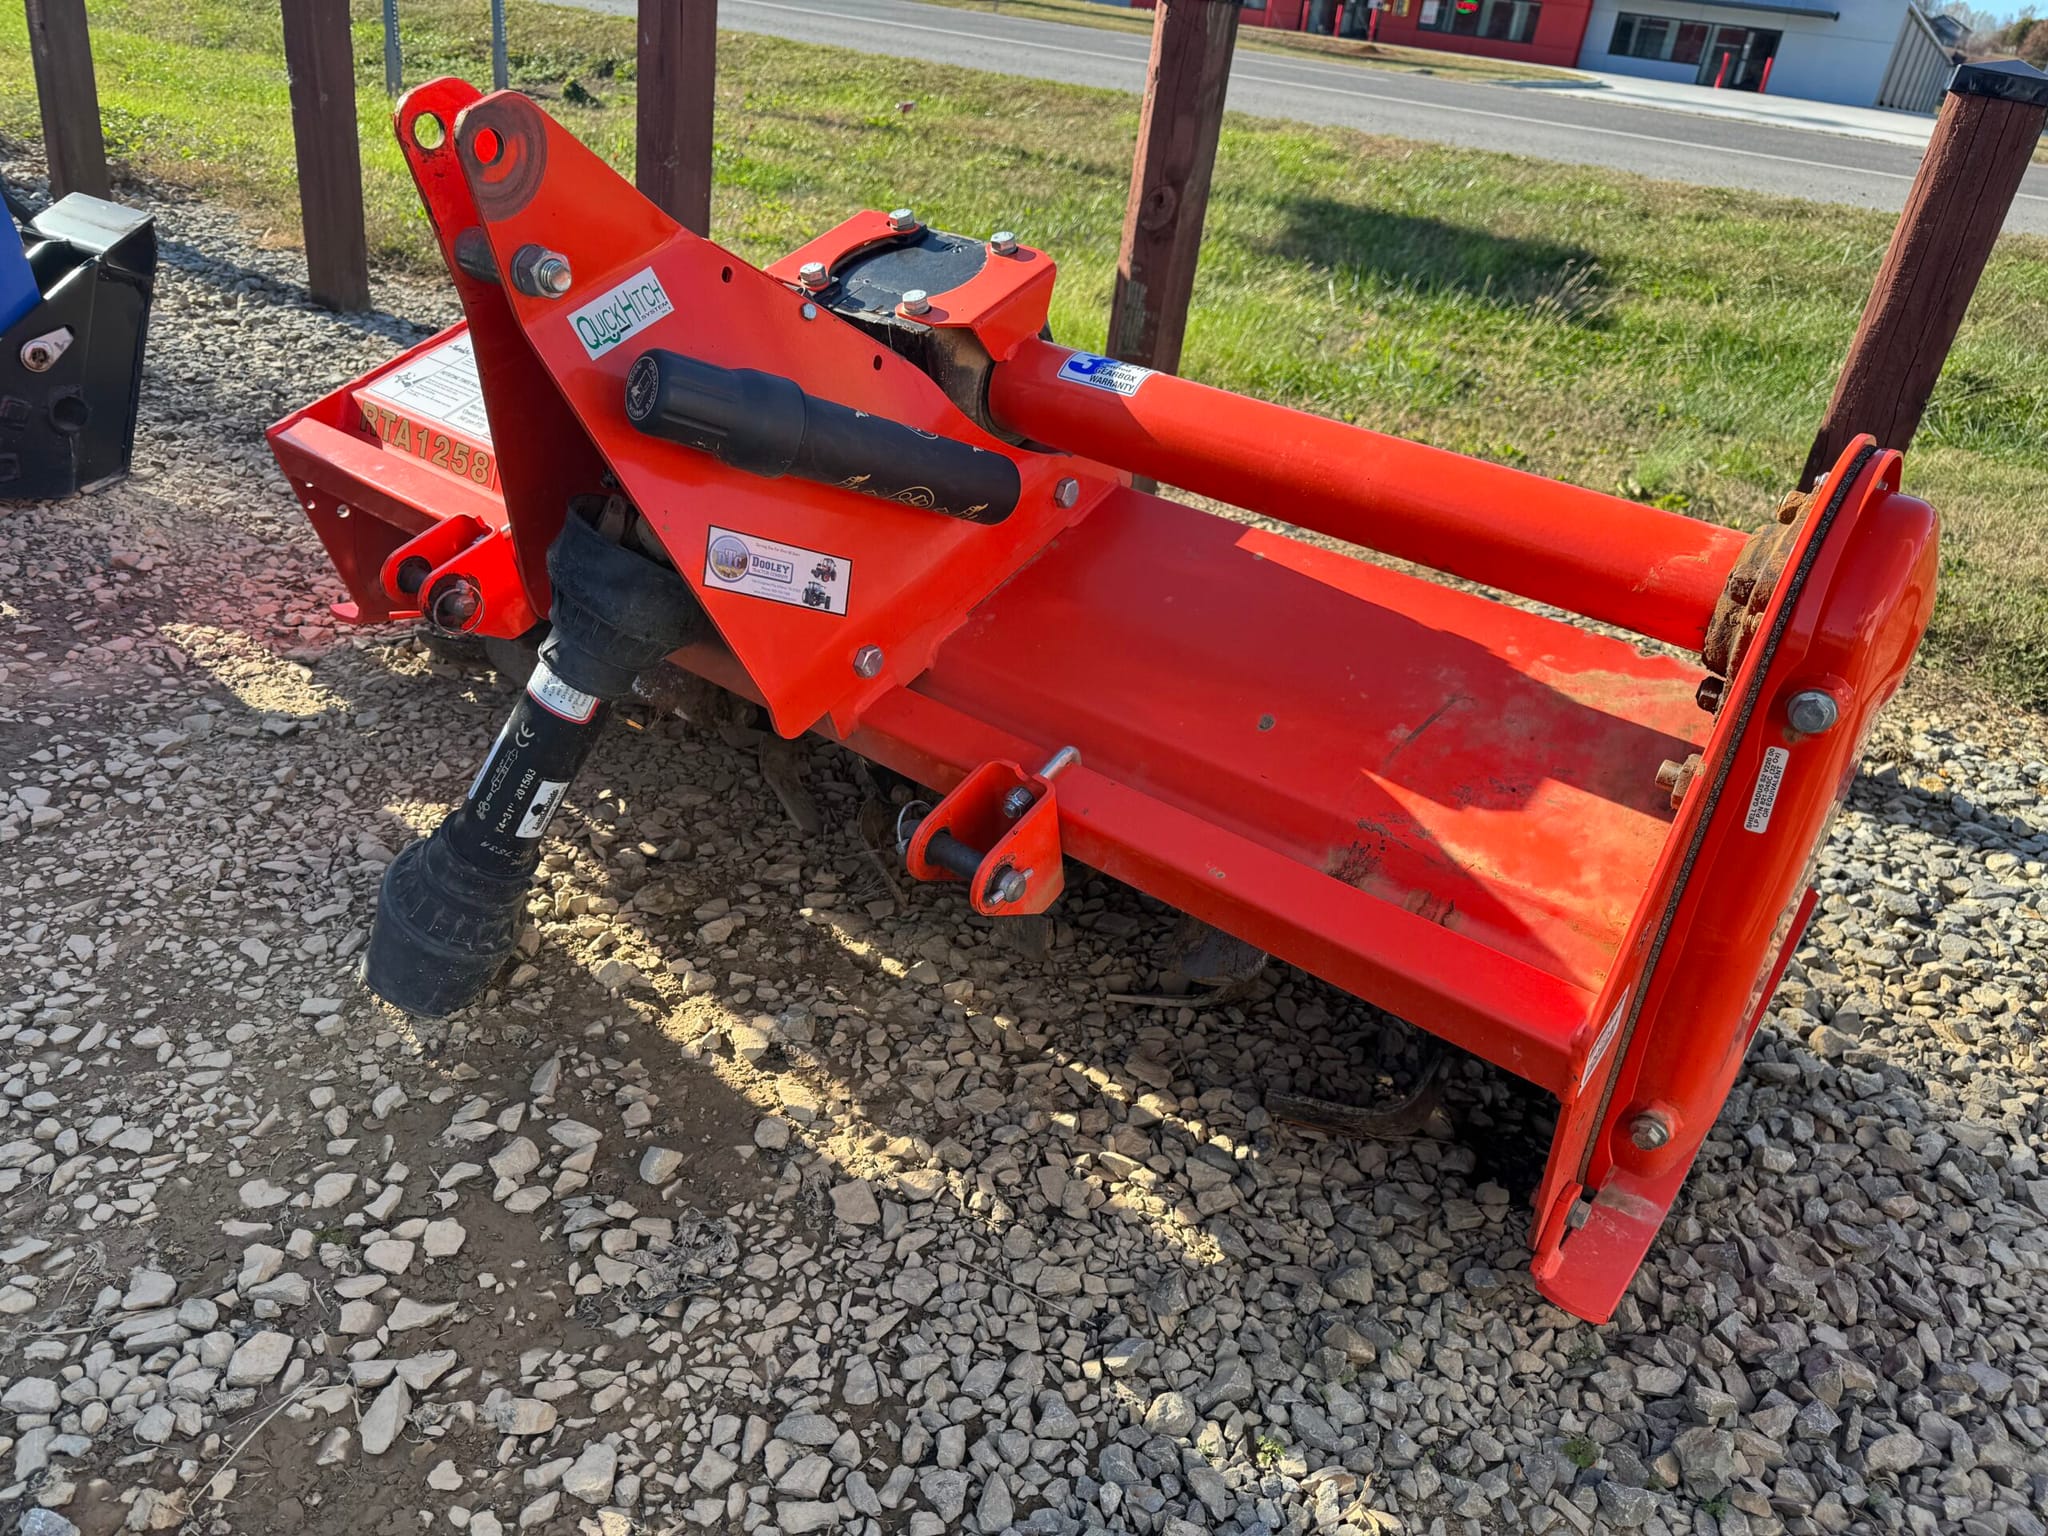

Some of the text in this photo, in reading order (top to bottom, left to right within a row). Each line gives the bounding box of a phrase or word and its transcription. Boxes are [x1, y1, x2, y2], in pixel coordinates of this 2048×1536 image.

[641, 300, 669, 320] SYSTEM
[1089, 375, 1135, 392] WARRANTY
[1095, 367, 1138, 383] GEARBOX
[752, 556, 790, 574] DOOLEY
[514, 768, 537, 801] 201503
[1746, 808, 1757, 829] SHELL
[1753, 783, 1764, 807] GADUS
[1763, 758, 1772, 773] V220
[1762, 766, 1783, 818] OR EQUIVALENT
[1753, 817, 1759, 828] LP
